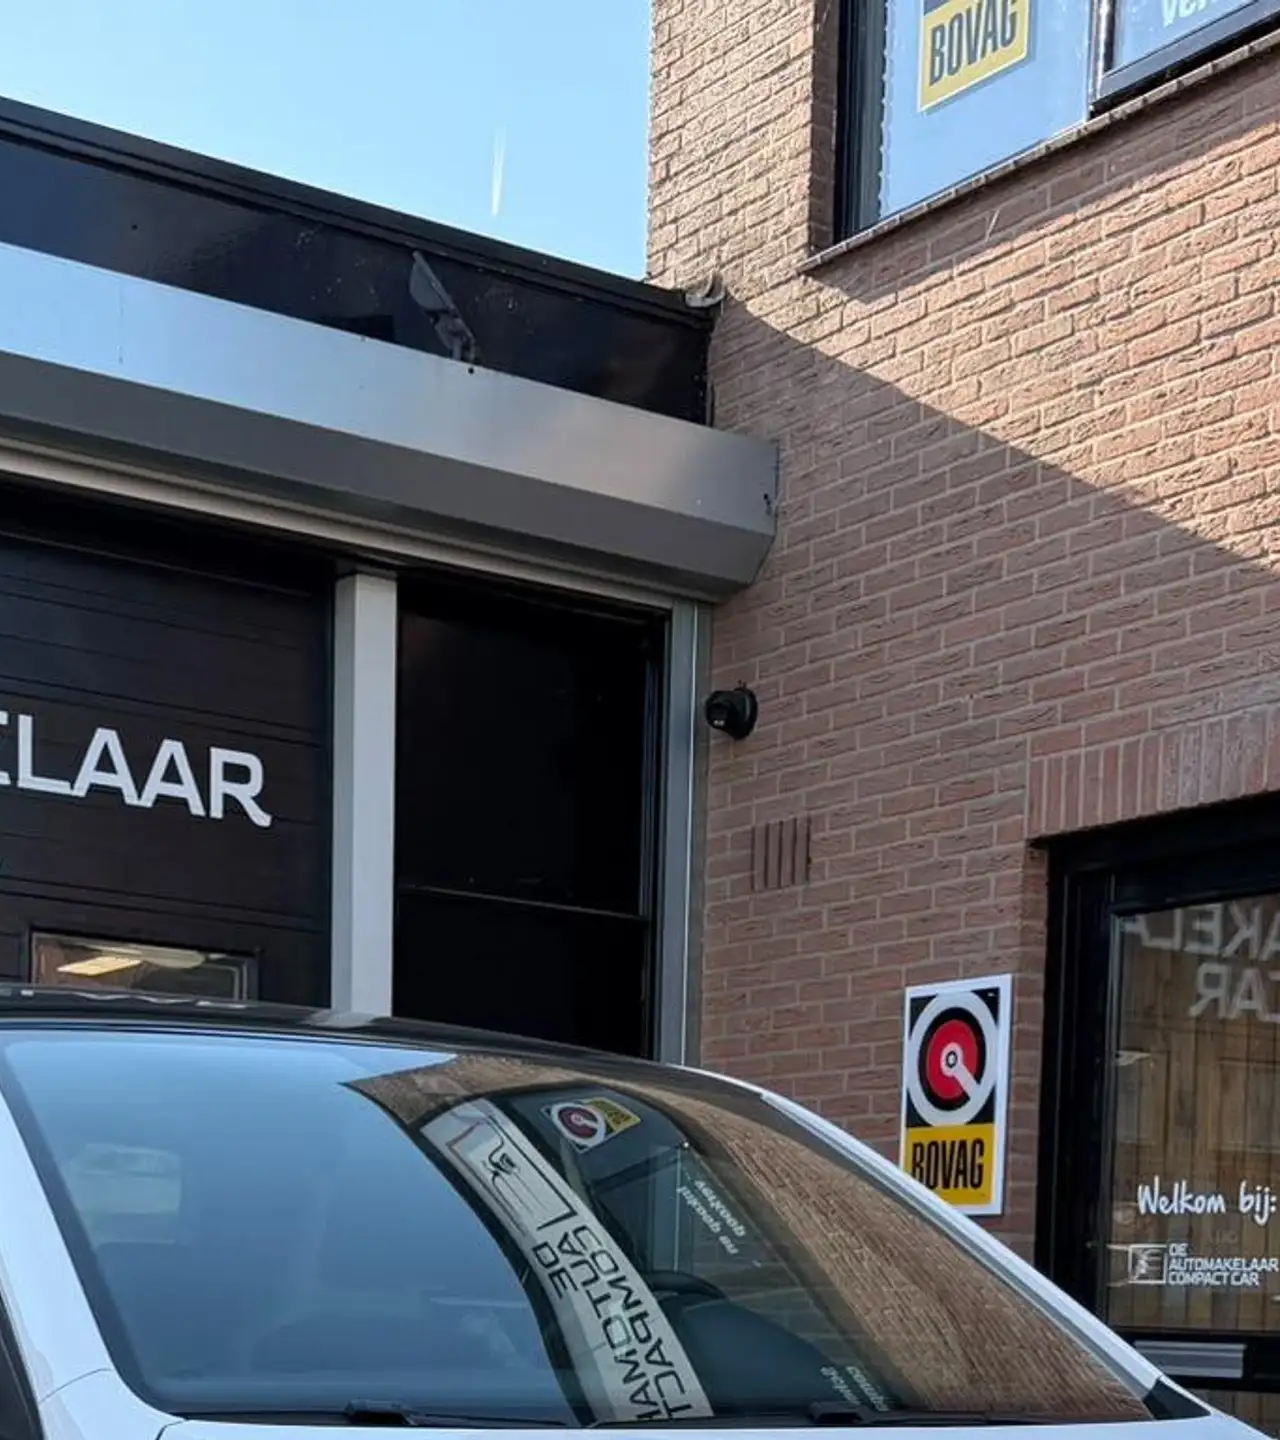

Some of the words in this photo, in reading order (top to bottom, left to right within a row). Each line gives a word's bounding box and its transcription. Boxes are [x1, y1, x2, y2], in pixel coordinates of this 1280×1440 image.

[929, 0, 1018, 86] BOVAG
[912, 1138, 985, 1190] BOVAG
[1137, 1175, 1226, 1215] Welkom
[1238, 1180, 1277, 1226] bij:
[1168, 1257, 1280, 1272] AUTOMAKELAAR
[1169, 1243, 1189, 1257] DE
[1168, 1271, 1229, 1286] COMPACT
[1230, 1272, 1260, 1287] CAR
